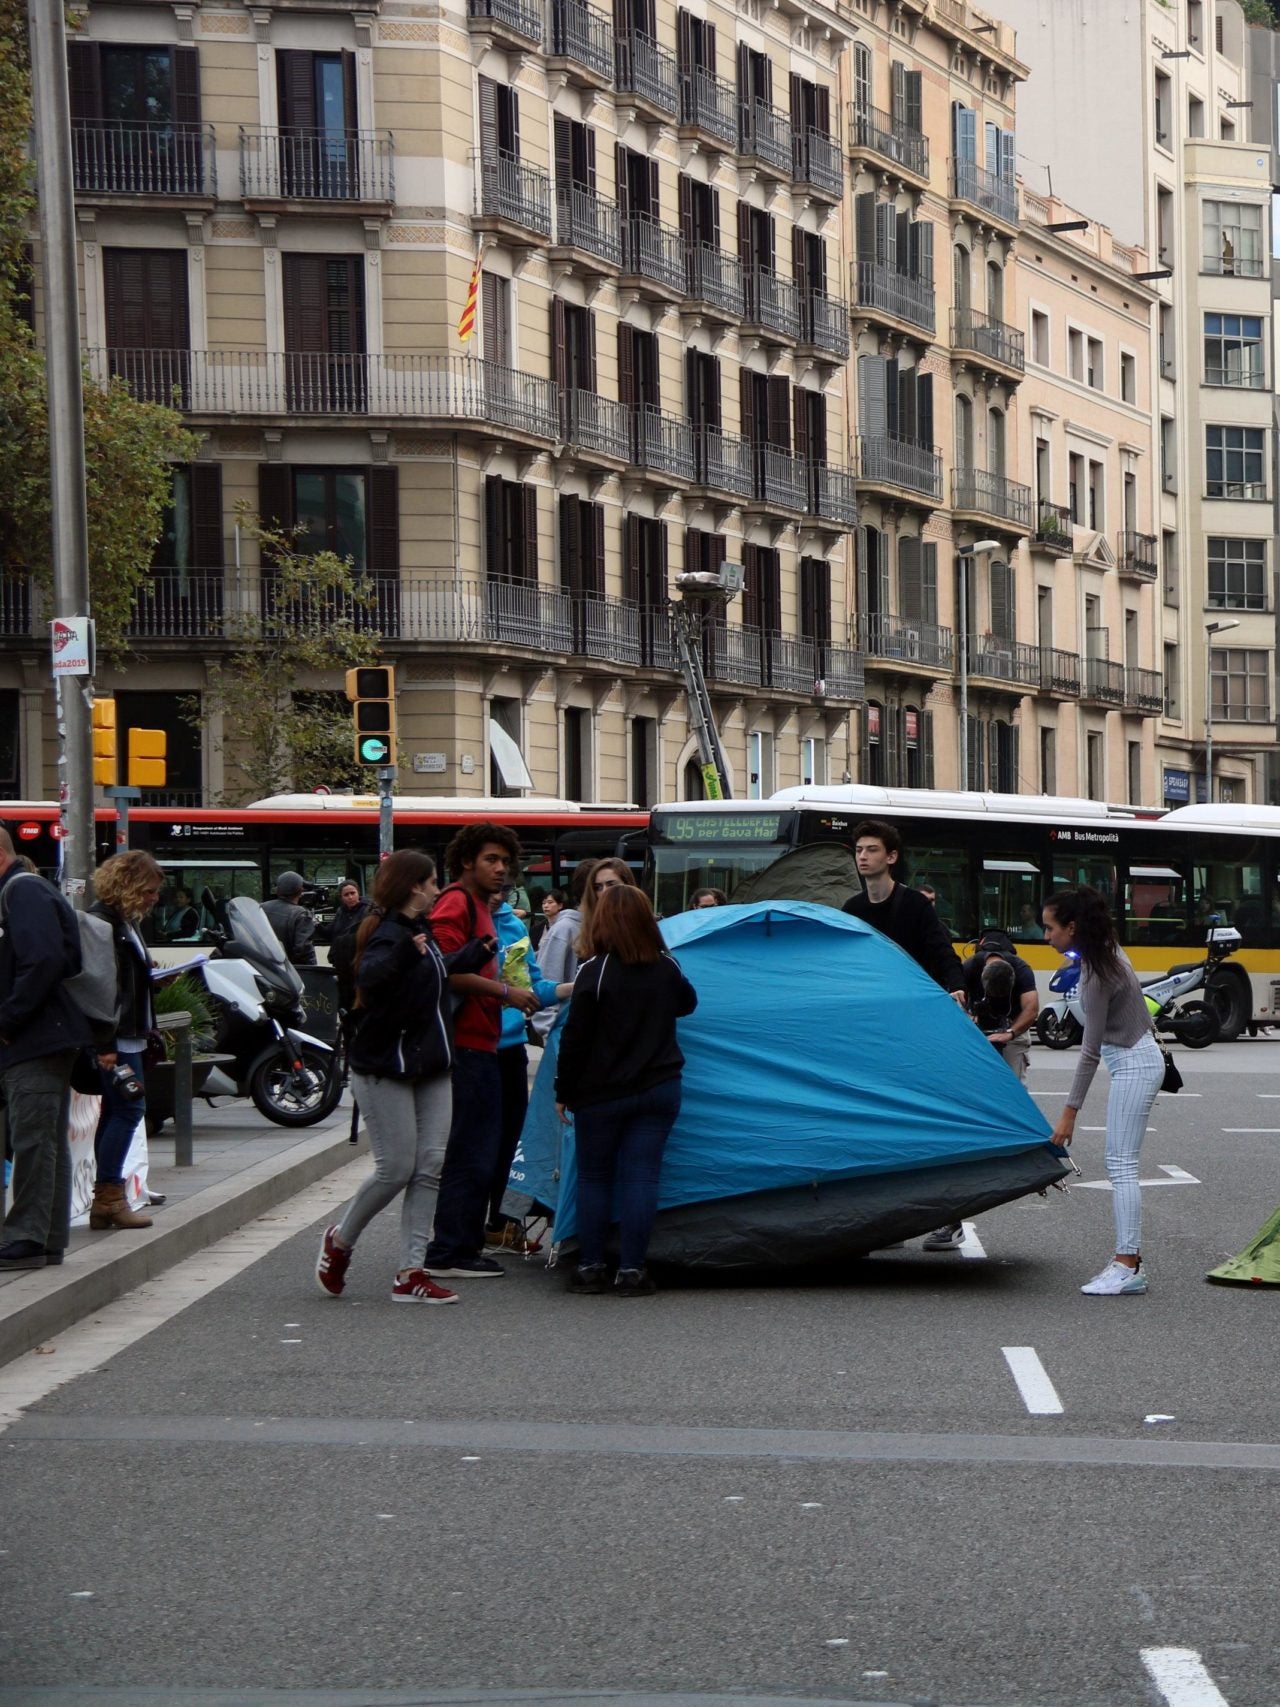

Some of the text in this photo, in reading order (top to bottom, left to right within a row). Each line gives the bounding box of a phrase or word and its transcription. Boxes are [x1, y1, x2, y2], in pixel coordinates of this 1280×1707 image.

[667, 817, 694, 840] L95
[1057, 831, 1071, 840] AMB
[1074, 831, 1085, 841] Bus
